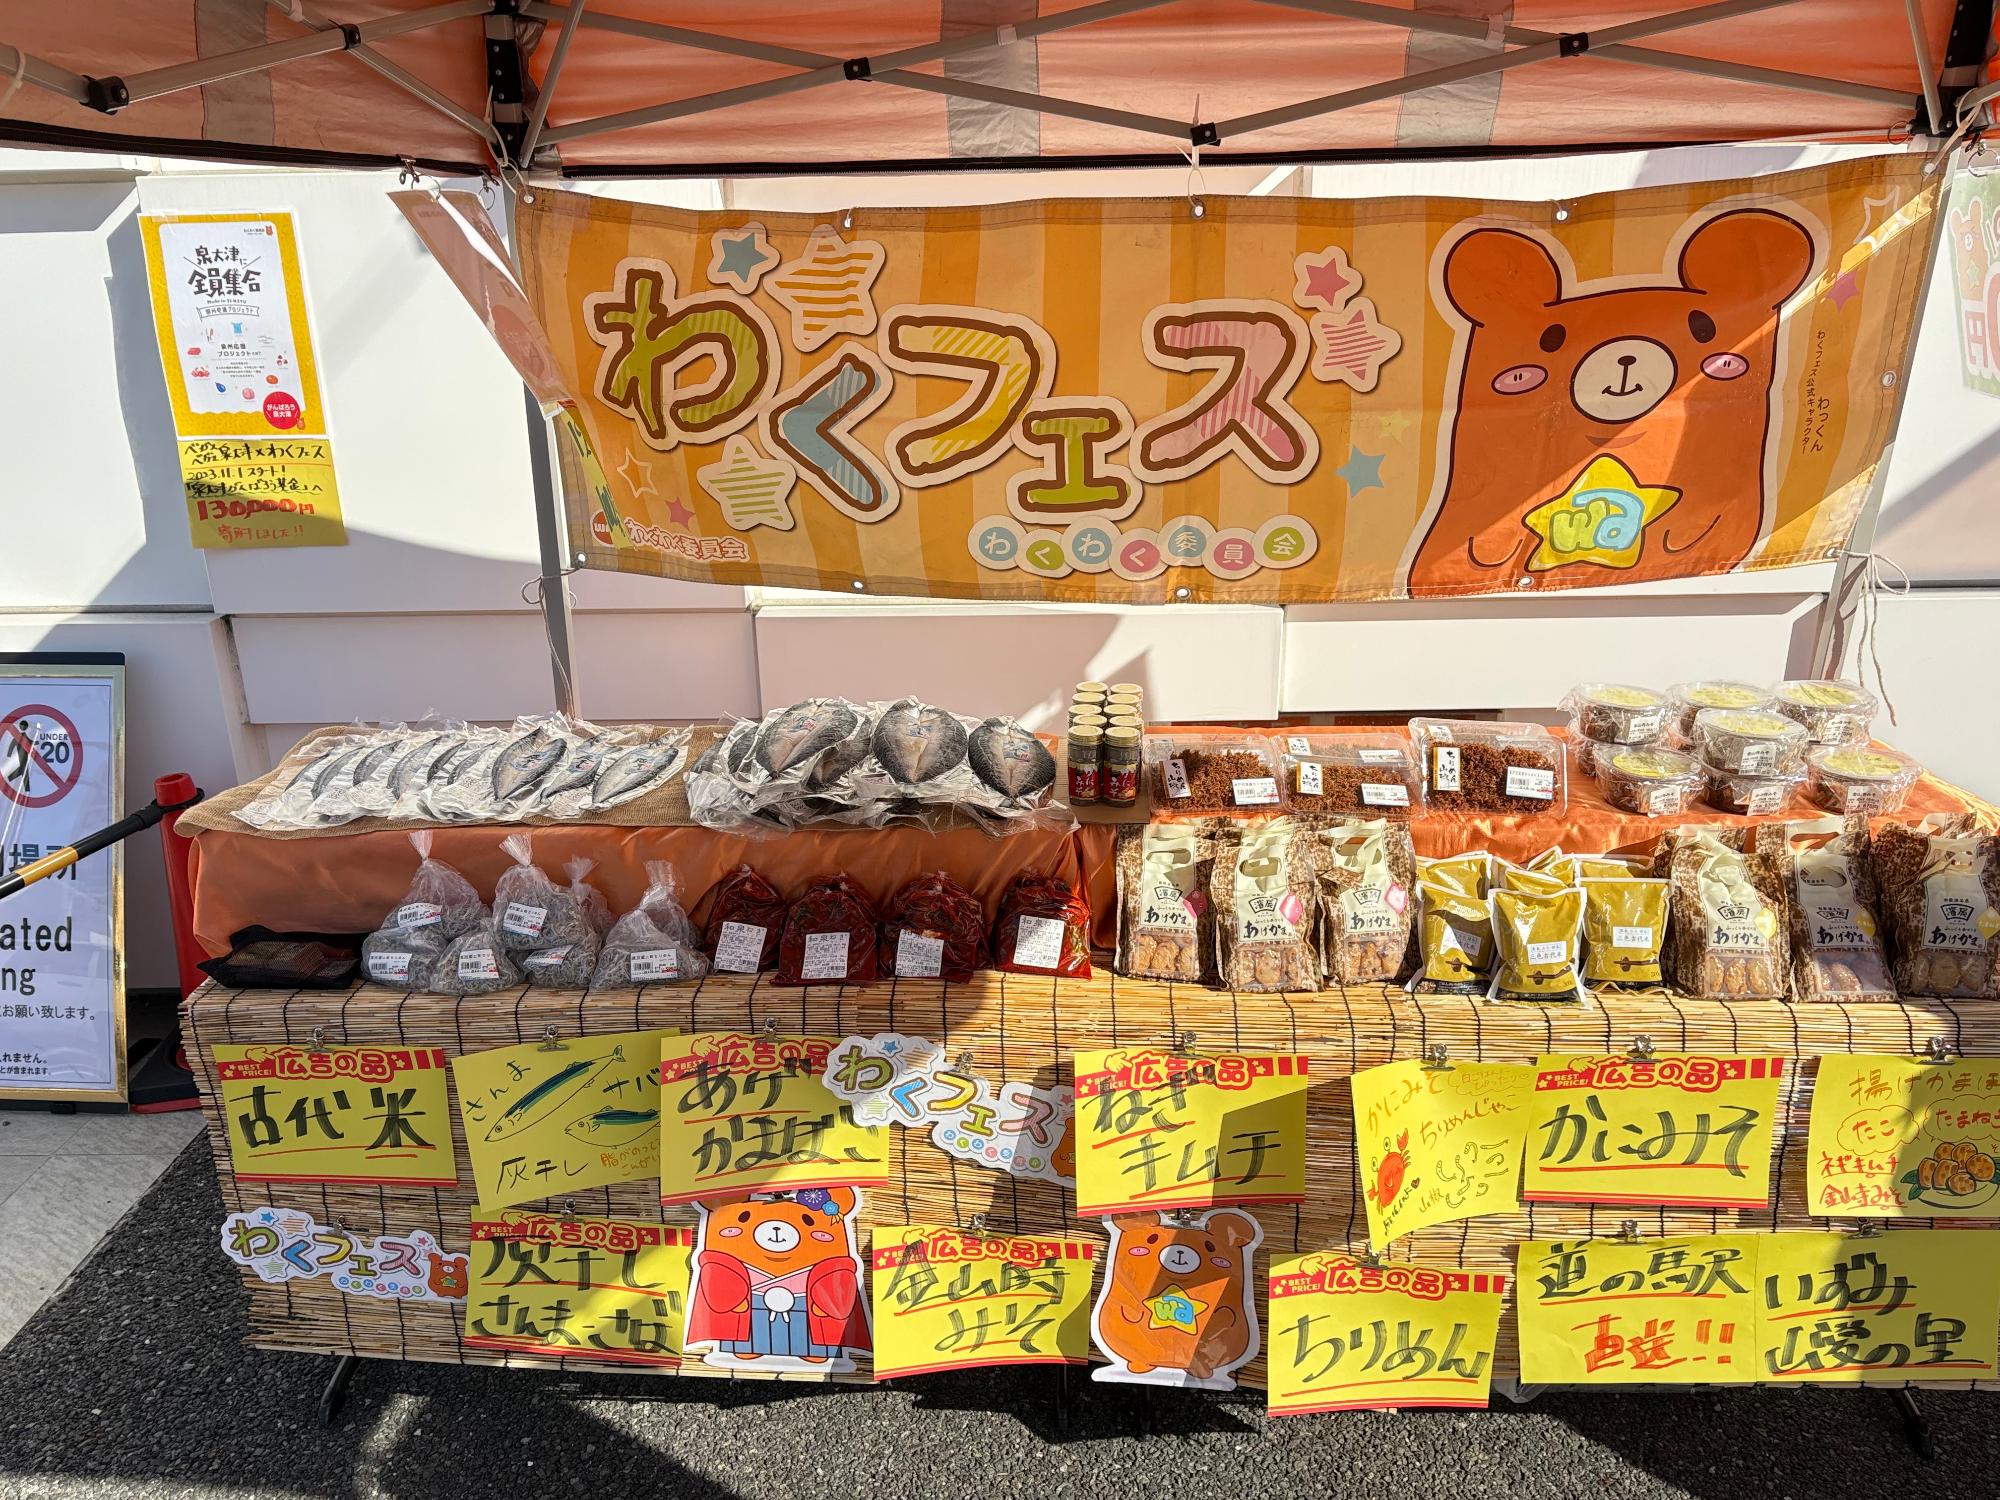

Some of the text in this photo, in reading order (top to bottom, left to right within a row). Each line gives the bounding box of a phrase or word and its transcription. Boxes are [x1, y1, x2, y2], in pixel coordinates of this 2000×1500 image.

[187, 267, 262, 297] 全員集合
[594, 266, 1310, 514] わくフェス
[1801, 329, 1826, 455] わくフェス公式キャラクター
[266, 403, 296, 411] がんばろう
[1810, 395, 1830, 453] わっくん
[980, 530, 1296, 568] わくわく委員会
[40, 733, 69, 741] UNDER
[40, 741, 70, 764] 20
[1144, 905, 1188, 925] あげかま
[1243, 919, 1288, 939] あげかま
[1350, 911, 1391, 930] あげかま
[1712, 925, 1760, 946] あげかま
[1816, 925, 1865, 945] あげかま
[1927, 925, 1978, 946] あげかま
[0, 1003, 95, 1021] お願い致します。
[0, 1052, 47, 1064] れません。
[276, 1050, 391, 1079] 広告の品
[719, 1038, 831, 1072] 広告の品
[1133, 1054, 1248, 1087] 広告の品
[466, 1060, 531, 1122] さんま
[1597, 1060, 1717, 1089] 広告の品
[833, 1044, 1054, 1145] わくフェス
[229, 1085, 436, 1150] 古代米
[1852, 1119, 1895, 1145] たこ
[1539, 1094, 1760, 1178] かにみそ
[600, 1138, 661, 1169] 脂がのって
[1119, 1131, 1281, 1192] キムチ
[496, 1156, 589, 1194] 灰干し
[229, 1219, 422, 1277] わくフェス
[528, 1218, 638, 1251] 広告の品
[929, 1233, 1039, 1266] 広告の品
[1327, 1262, 1442, 1296] 広告の品
[1537, 1240, 1751, 1298] 道の駅
[1765, 1251, 1918, 1317] いずみ
[934, 1302, 1057, 1354] みそ
[1278, 1314, 1491, 1384] ちりめん
